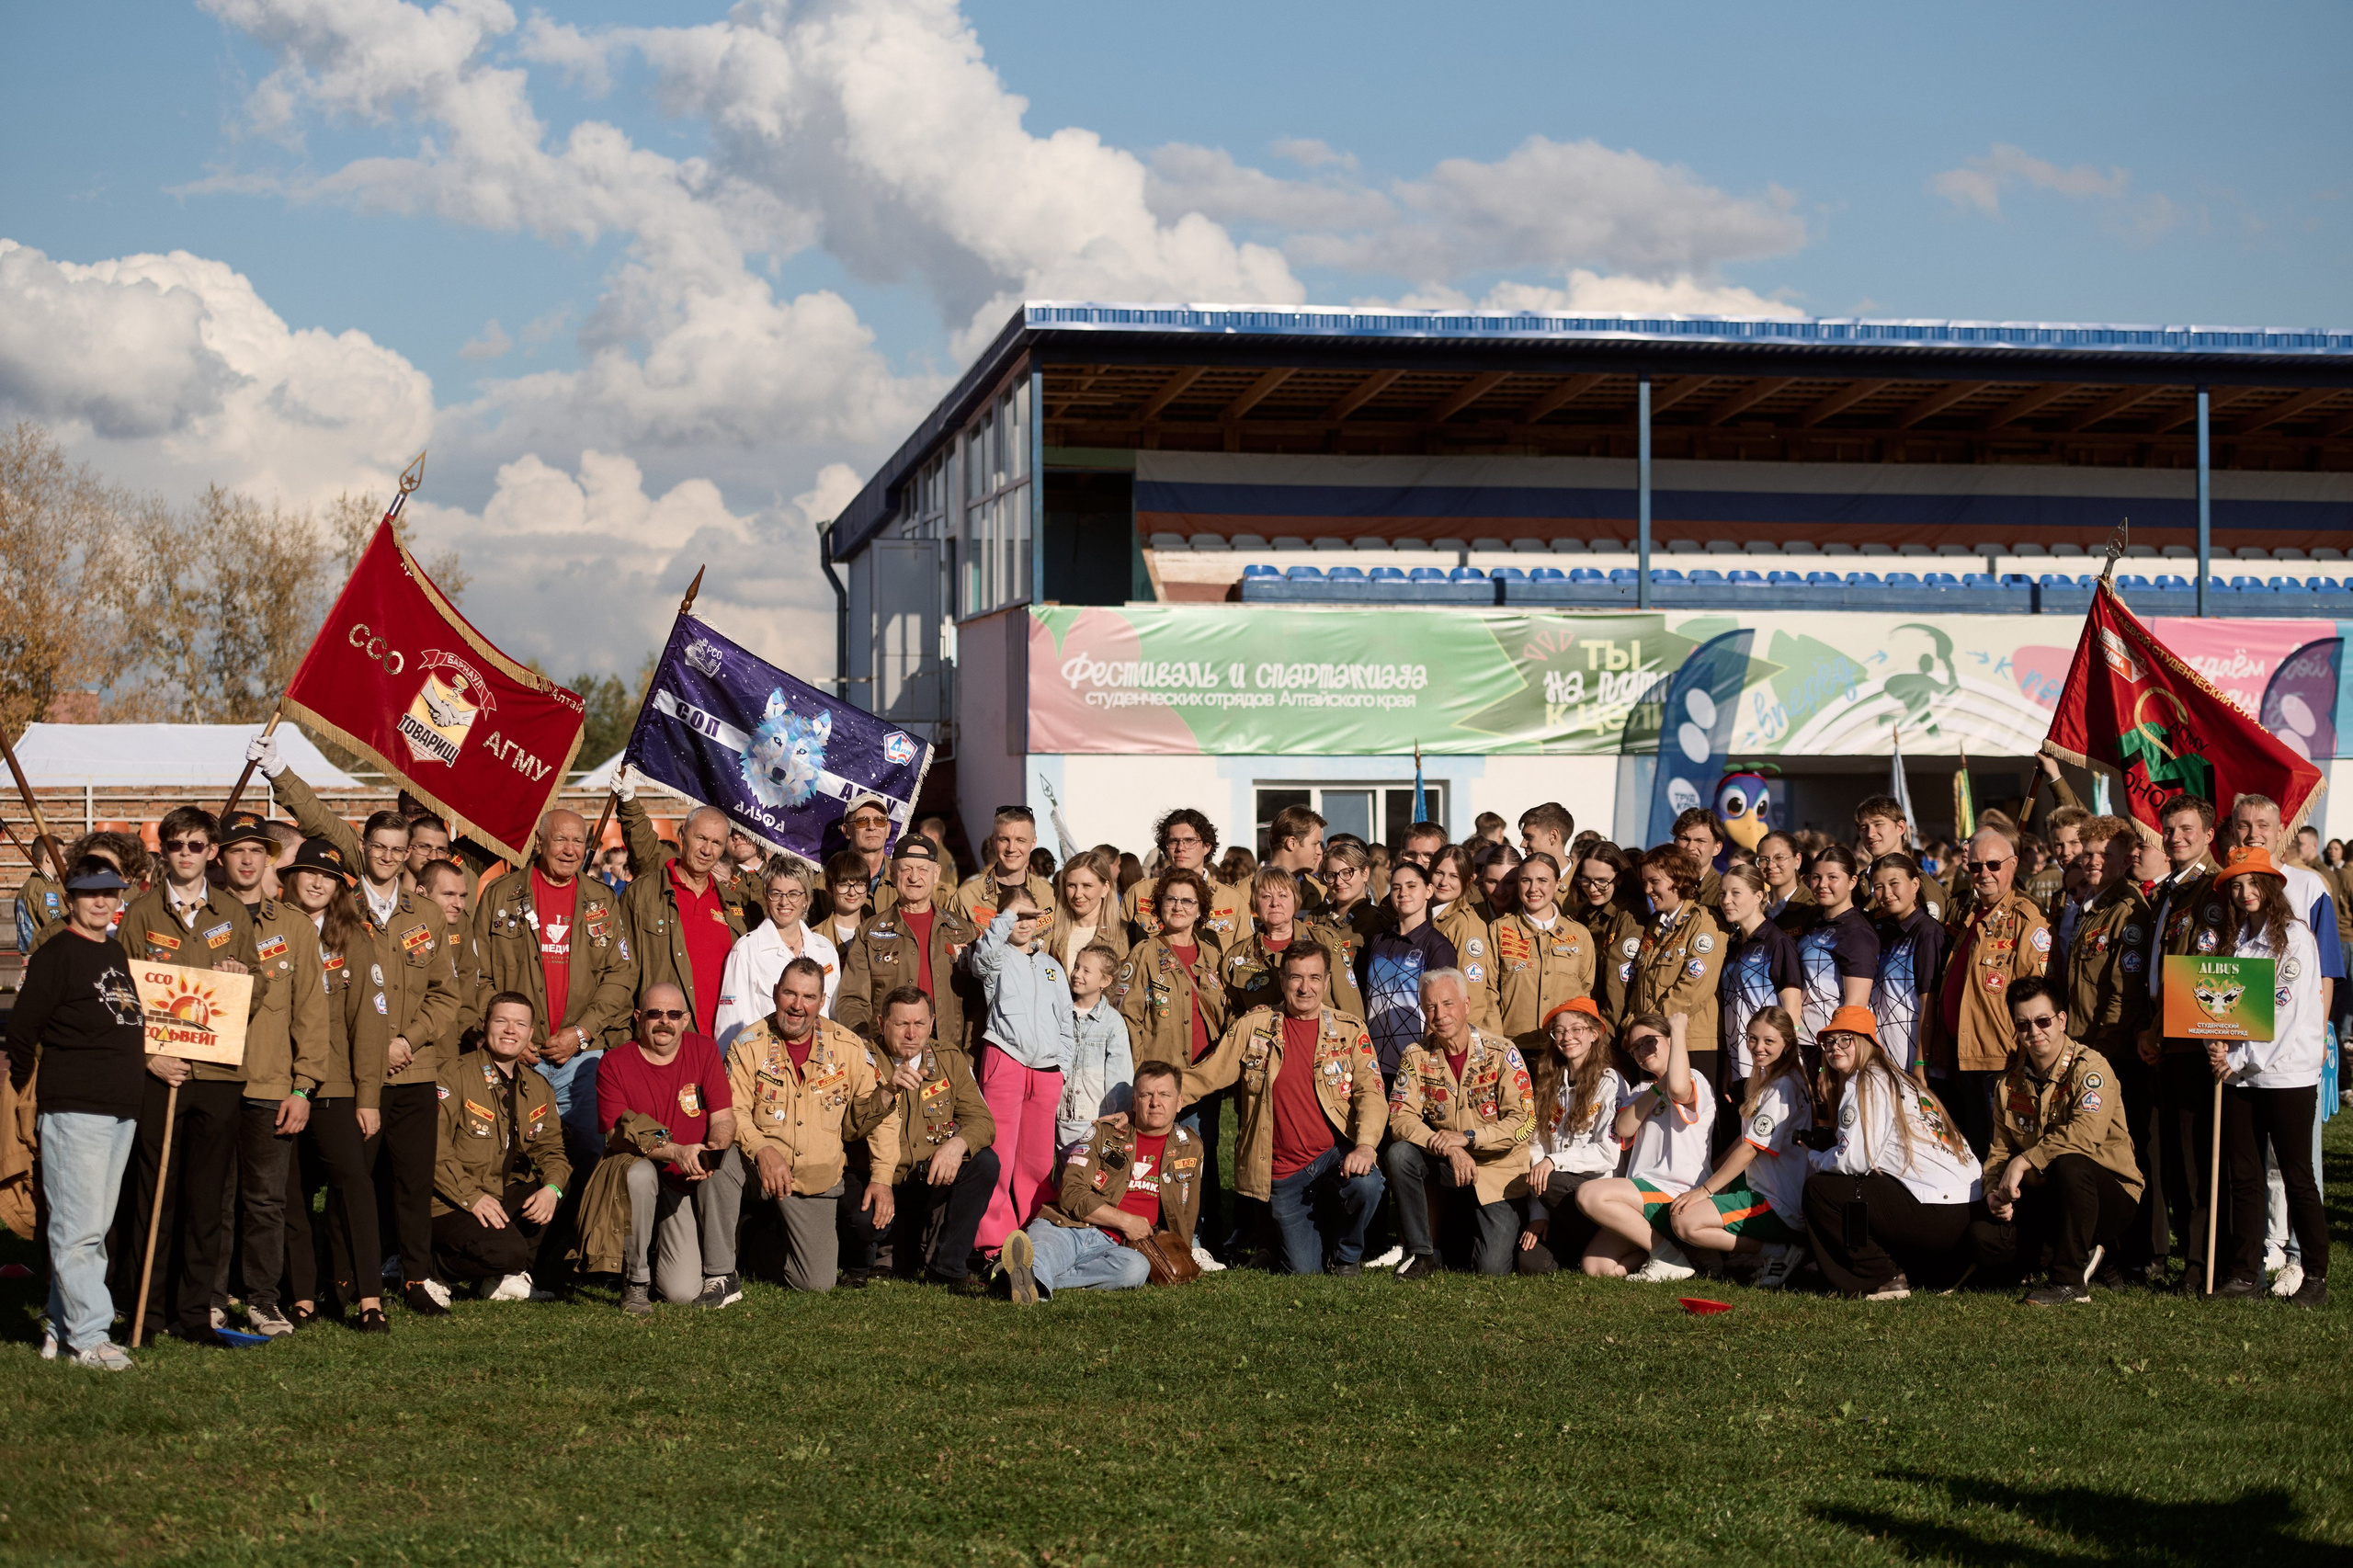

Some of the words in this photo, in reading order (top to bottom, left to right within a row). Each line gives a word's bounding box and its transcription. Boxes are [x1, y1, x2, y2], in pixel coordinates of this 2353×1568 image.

[2106, 605, 2152, 648] КРАЕВОЙ
[348, 623, 404, 676] ССО
[706, 644, 723, 660] РСО
[447, 654, 484, 690] БАРНАУЛ
[1061, 652, 1219, 689] Фестиваль
[1229, 662, 1245, 689] и
[1256, 662, 1427, 690] спартакиада
[1543, 670, 1586, 704] на
[551, 688, 584, 714] Алтай
[1086, 691, 1202, 710] студенческих
[1203, 692, 1275, 710] отрядов
[1279, 689, 1375, 708] Алтайского
[1377, 692, 1416, 711] края
[675, 701, 722, 738] СОП
[396, 713, 461, 768] ТОВАРИЩ
[2167, 722, 2209, 752] АГМУ
[483, 730, 552, 782] АГМУ
[541, 943, 570, 955] МЕДИ
[144, 971, 174, 985] ССО
[2198, 962, 2240, 975] ALBUS
[2188, 1028, 2230, 1036] МЕДИЦИНСКИЙ
